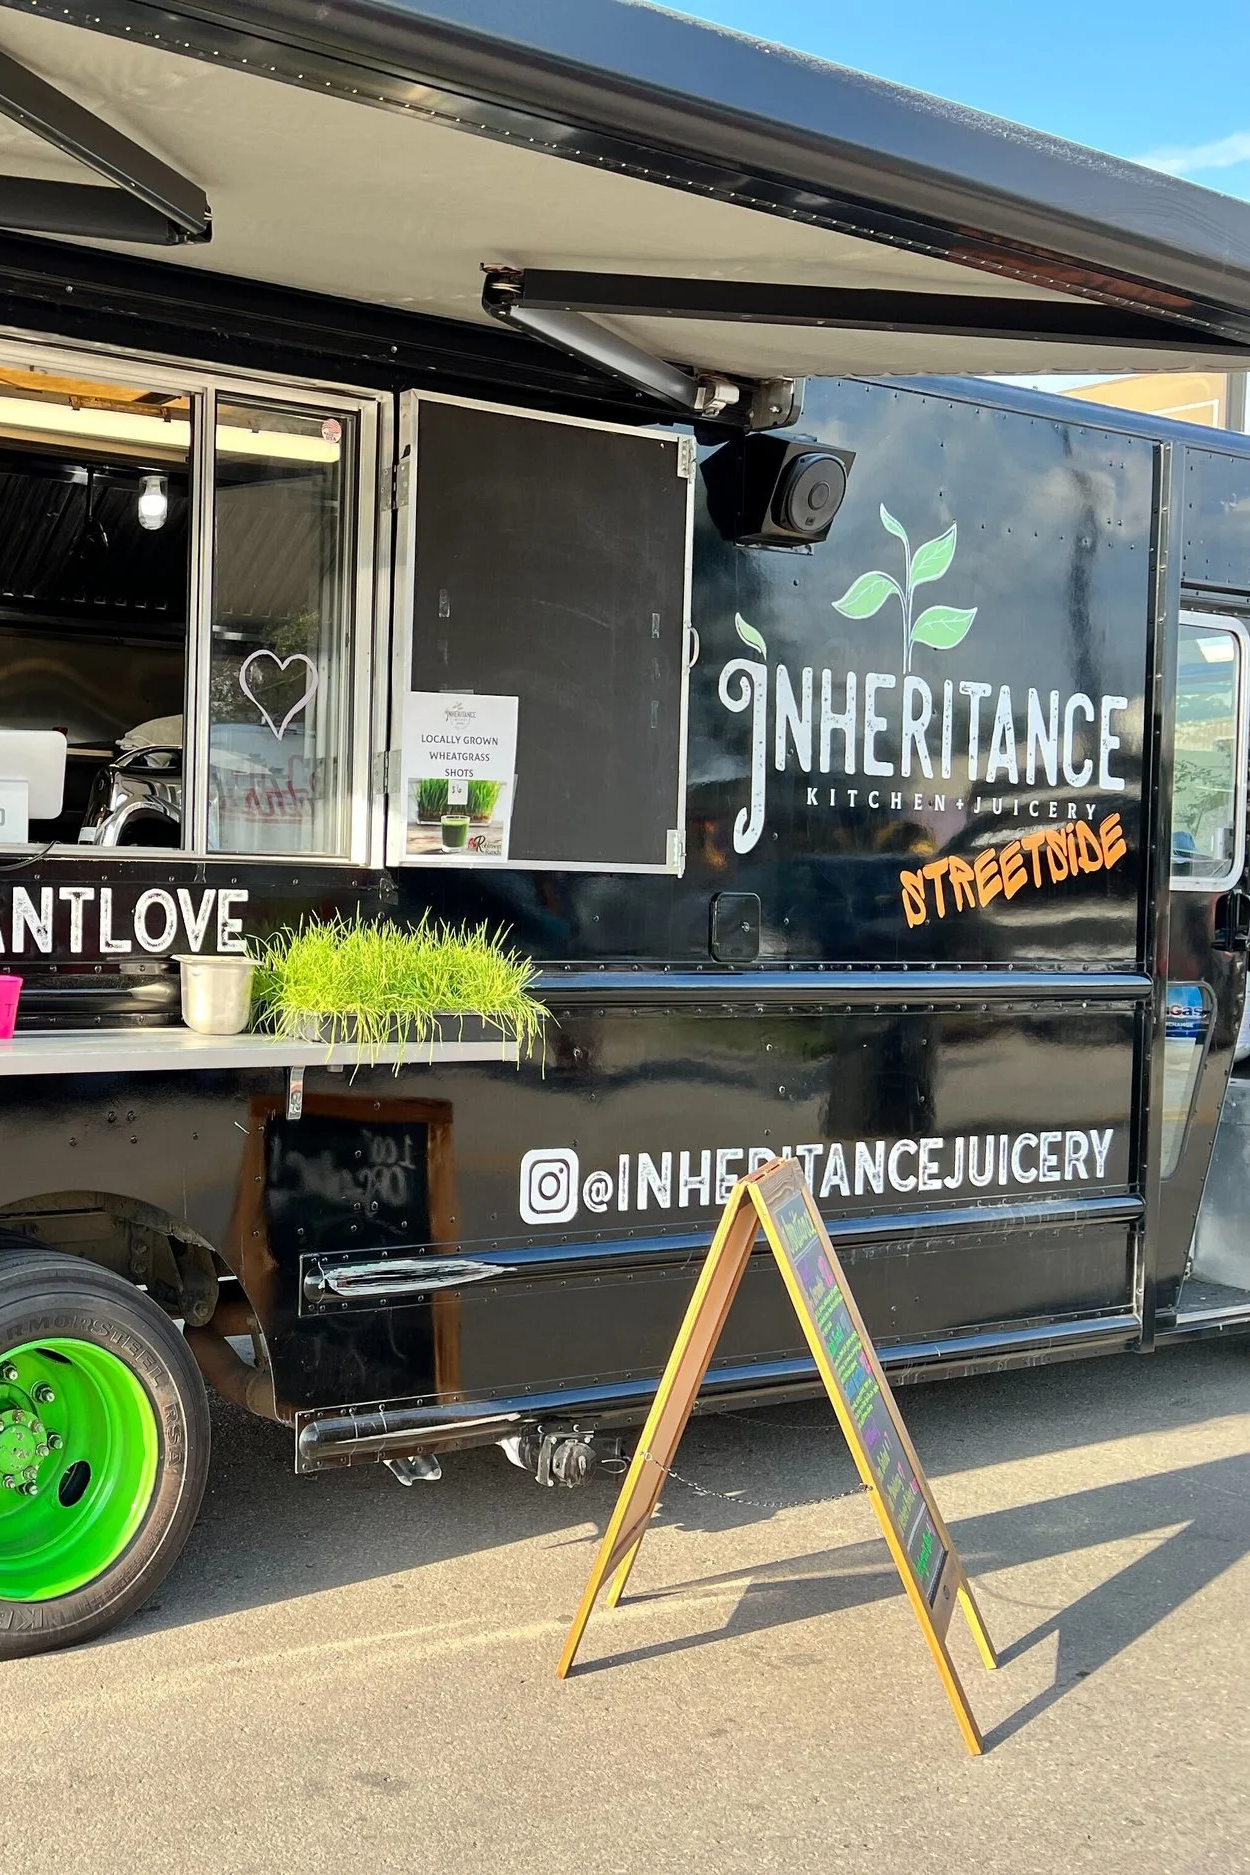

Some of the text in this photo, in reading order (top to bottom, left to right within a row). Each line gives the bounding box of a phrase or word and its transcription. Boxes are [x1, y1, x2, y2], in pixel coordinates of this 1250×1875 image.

[421, 733, 499, 746] LOCALLY GROWN
[429, 751, 490, 762] WHEATGRASS
[718, 657, 1128, 855] INHERITANCE
[444, 768, 474, 778] SHOTS
[582, 1128, 1115, 1214] @INHETANCEJUICERY
